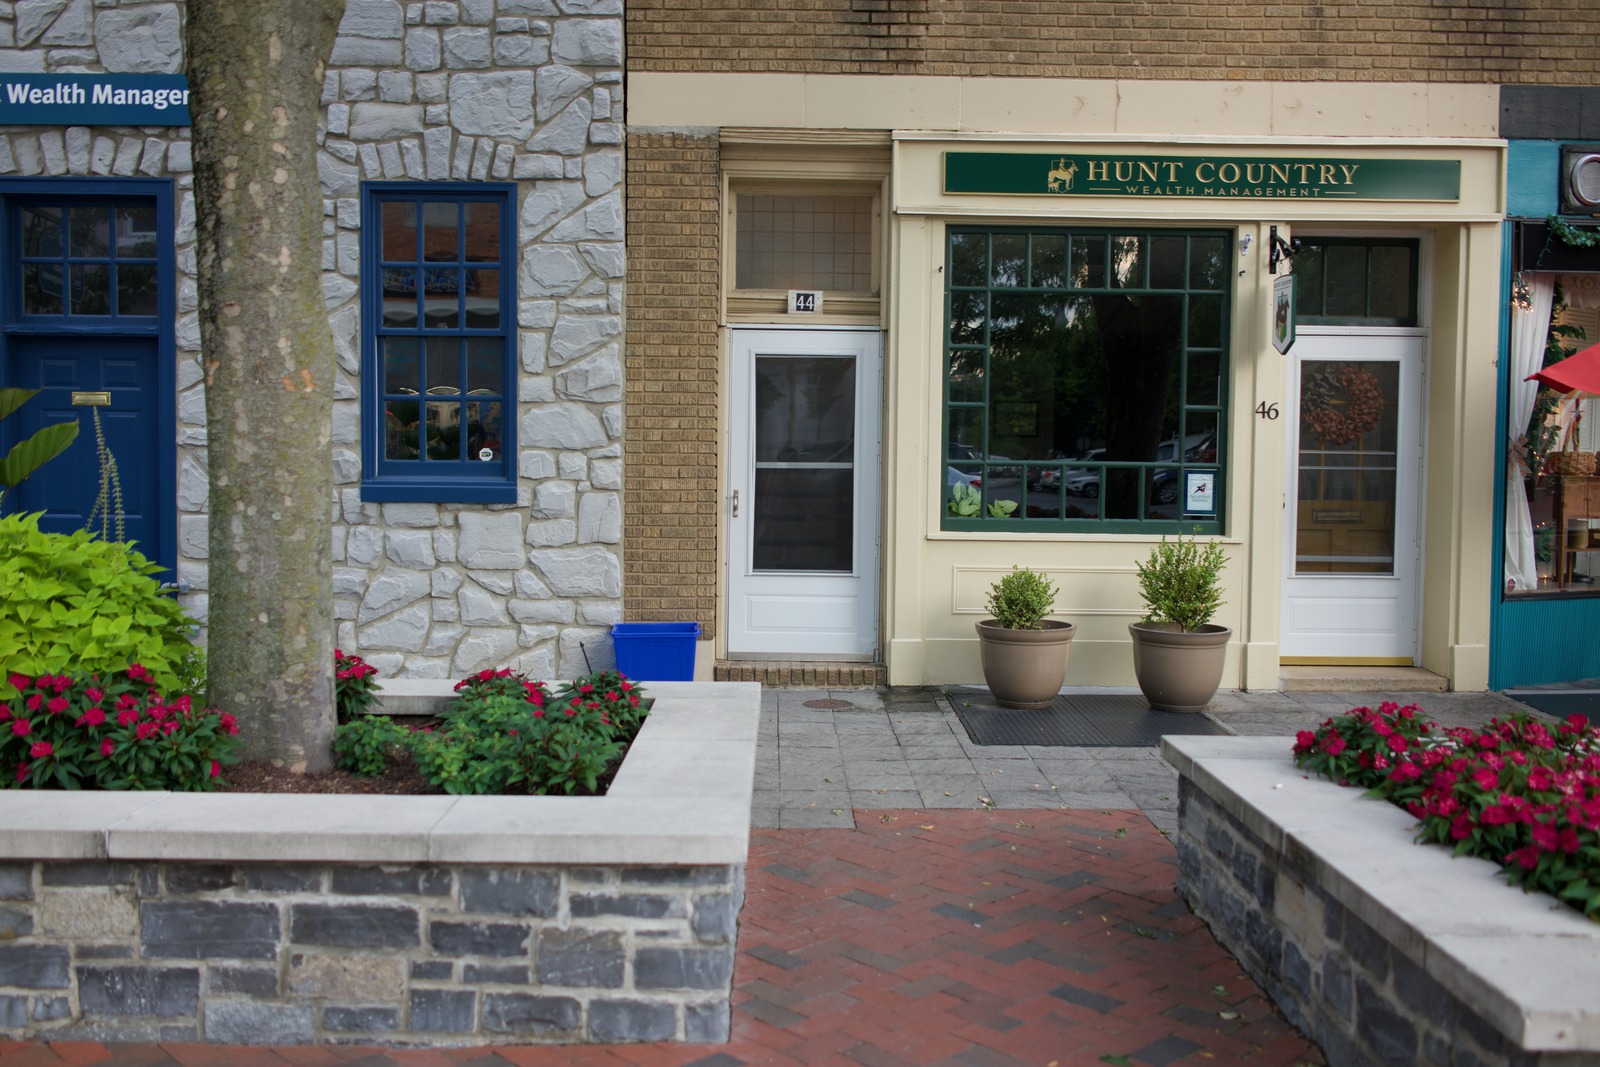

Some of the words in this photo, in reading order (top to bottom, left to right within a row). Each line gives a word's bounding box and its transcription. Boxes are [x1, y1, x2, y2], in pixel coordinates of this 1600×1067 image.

[6, 82, 86, 104] Wealth
[1086, 160, 1184, 182] HUNT
[1195, 162, 1360, 185] COUNTRY
[1125, 185, 1195, 195] WEALTH
[1204, 187, 1320, 197] MANAGEMENT
[796, 295, 814, 310] 44
[1255, 400, 1280, 420] 46
